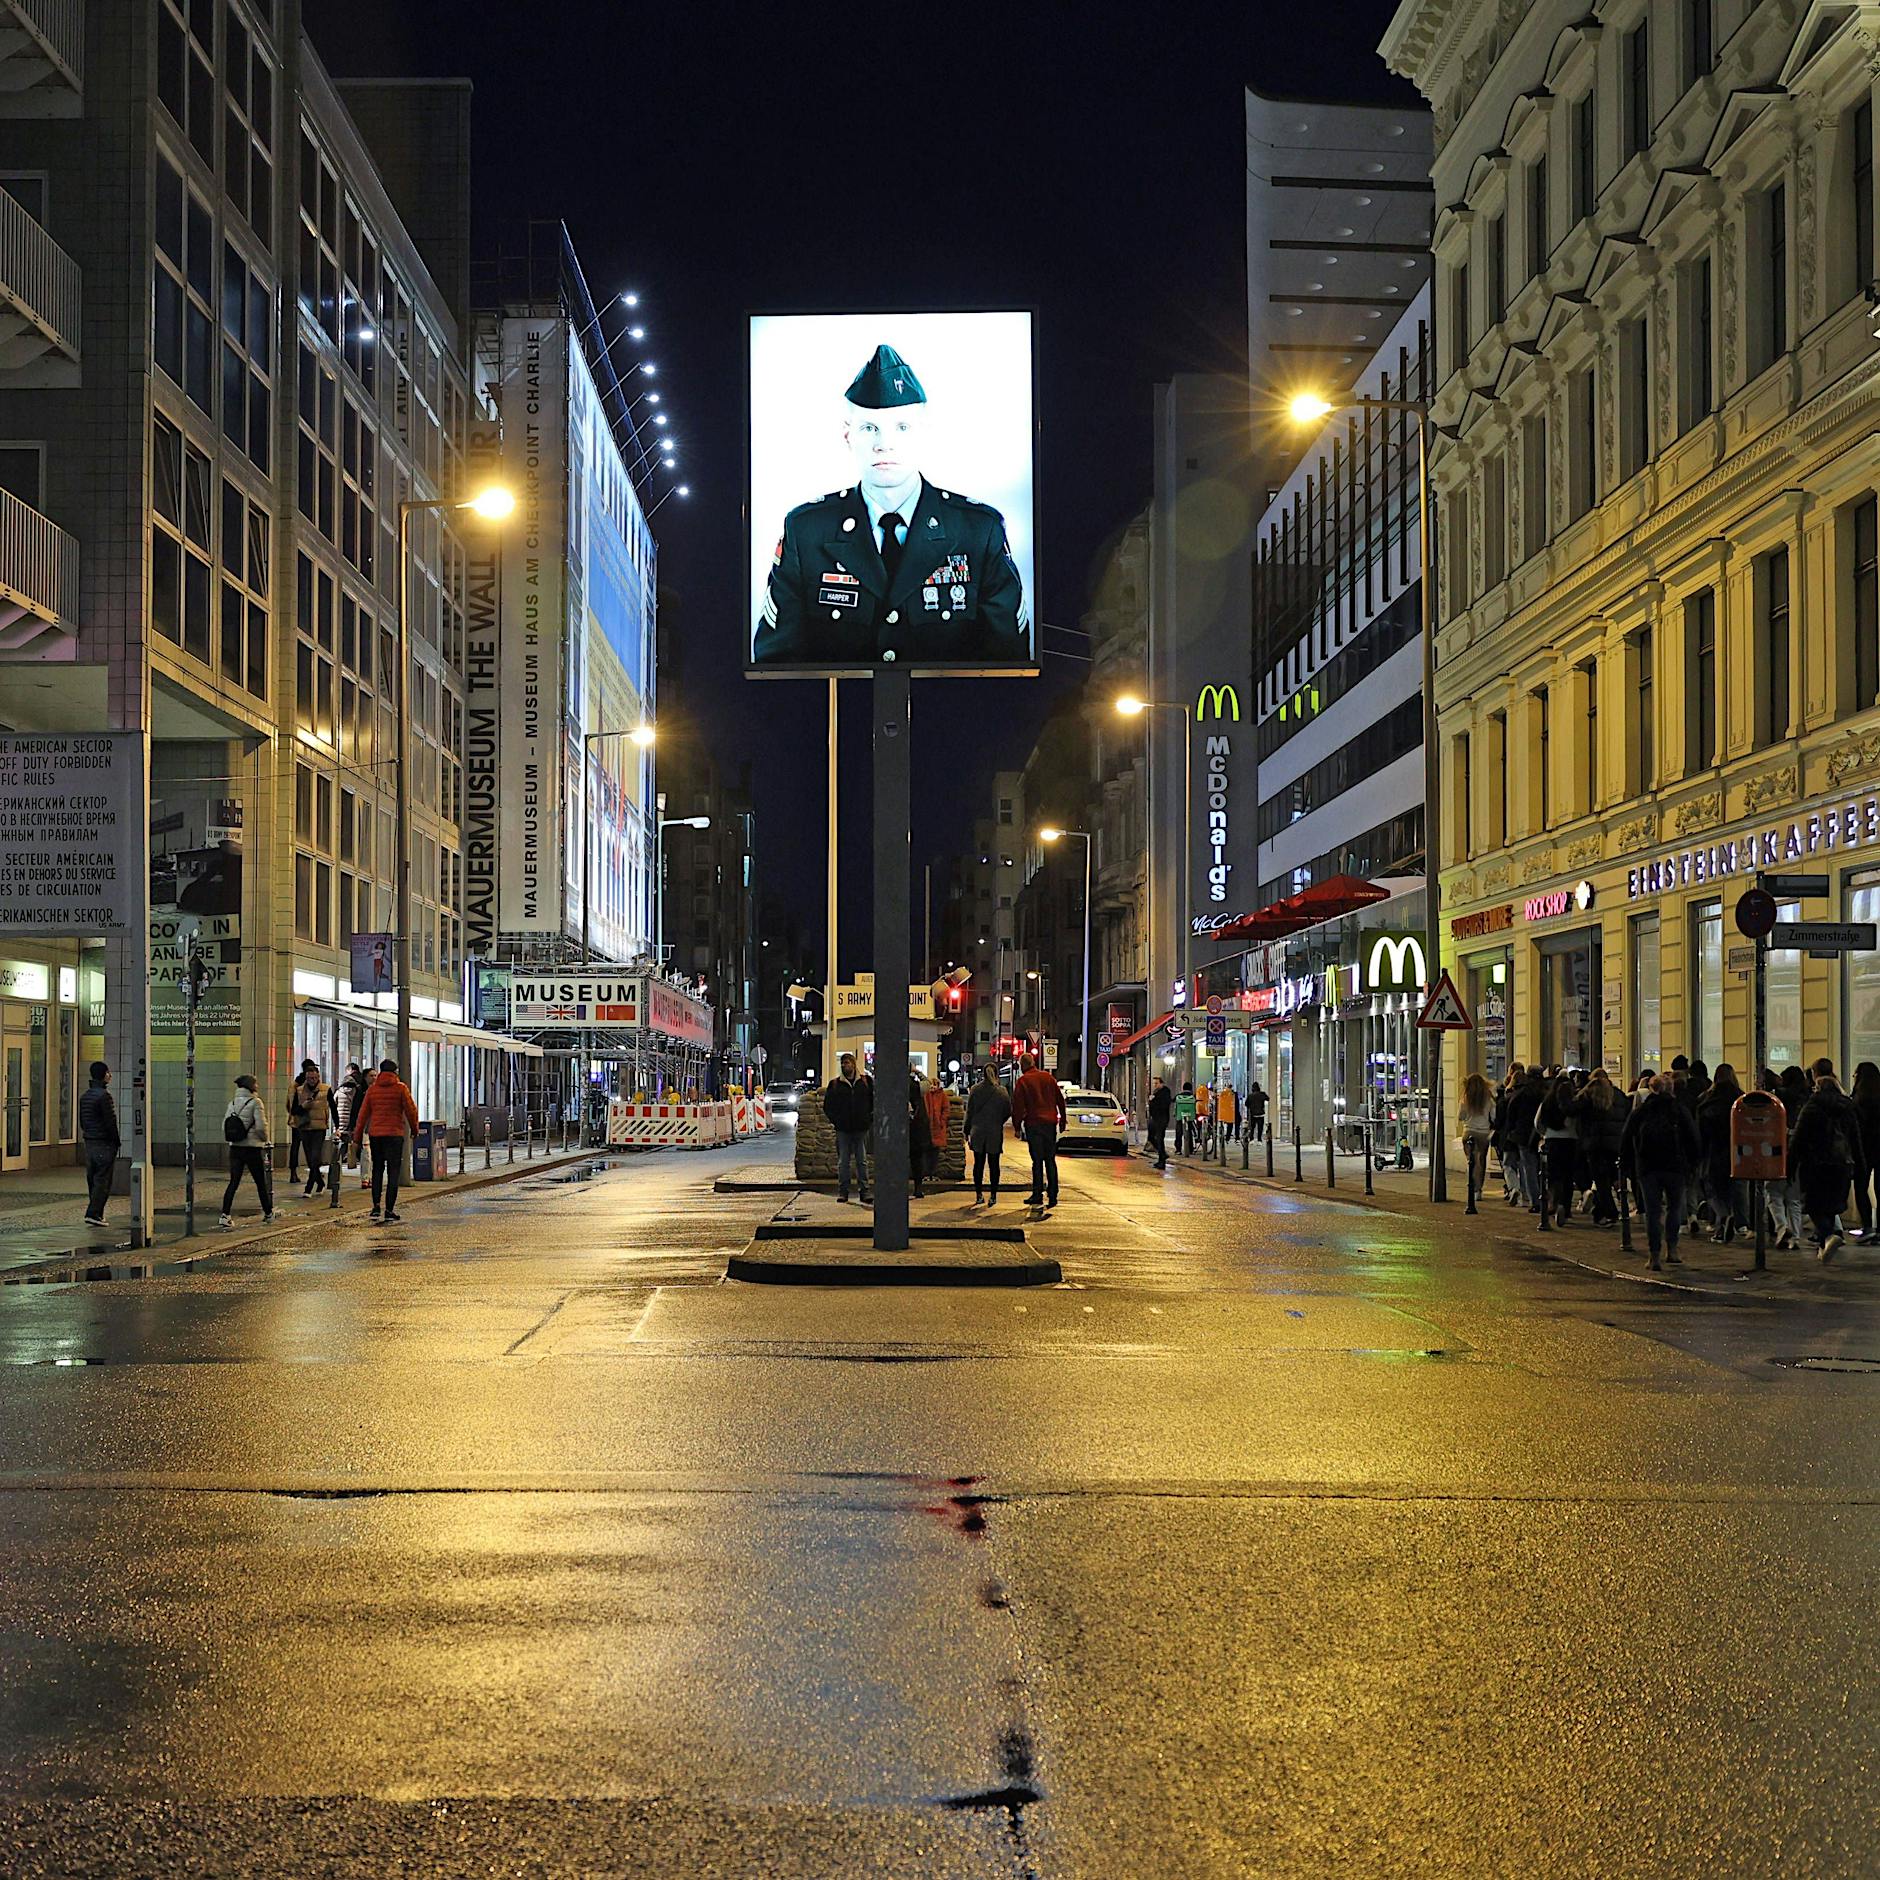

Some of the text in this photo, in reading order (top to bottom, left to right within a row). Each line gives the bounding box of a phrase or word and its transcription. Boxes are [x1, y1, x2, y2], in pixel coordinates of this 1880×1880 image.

[527, 331, 540, 414] CHARLIE
[526, 425, 540, 549] CHECKPOINT
[526, 558, 539, 586] AM
[468, 553, 496, 633] WALL
[826, 592, 850, 602] HARPER
[526, 594, 539, 645] HAUS
[468, 641, 495, 693] THE
[525, 654, 538, 738] MUSEUM
[15, 740, 67, 754] AMERICAN
[73, 740, 113, 754] SECTOR
[0, 755, 112, 770] OFF DUTY FORBIDDEN
[24, 772, 55, 786] RULES
[70, 796, 108, 810] СЕКТОР
[86, 812, 116, 825] ВРЕМЯ
[1205, 736, 1232, 902] McDonald's
[41, 828, 98, 841] ПРАВИЛАМ
[467, 709, 496, 949] MAUERMUSEUM
[525, 764, 538, 918] MAUERMUSEUM
[1627, 800, 1880, 899] EINSTEIN KAFFEE
[5, 849, 114, 866] SECTEUR AMÉRICAIN
[14, 869, 25, 880] EN
[28, 867, 62, 880] DEHORS
[66, 868, 78, 879] DU
[80, 867, 116, 880] SERVICE
[18, 884, 30, 896] DE
[36, 883, 102, 896] CIRCULATION
[1524, 891, 1568, 921] ROCK SHOP
[74, 907, 114, 923] SEKTOR
[149, 918, 230, 940] CO IN
[149, 967, 186, 983] PAR
[515, 984, 636, 1002] MUSEUM
[847, 992, 872, 1006] ARMY
[151, 1020, 171, 1028] ickets
[194, 1020, 211, 1029] Shop
[1208, 1036, 1225, 1044] TAXI
